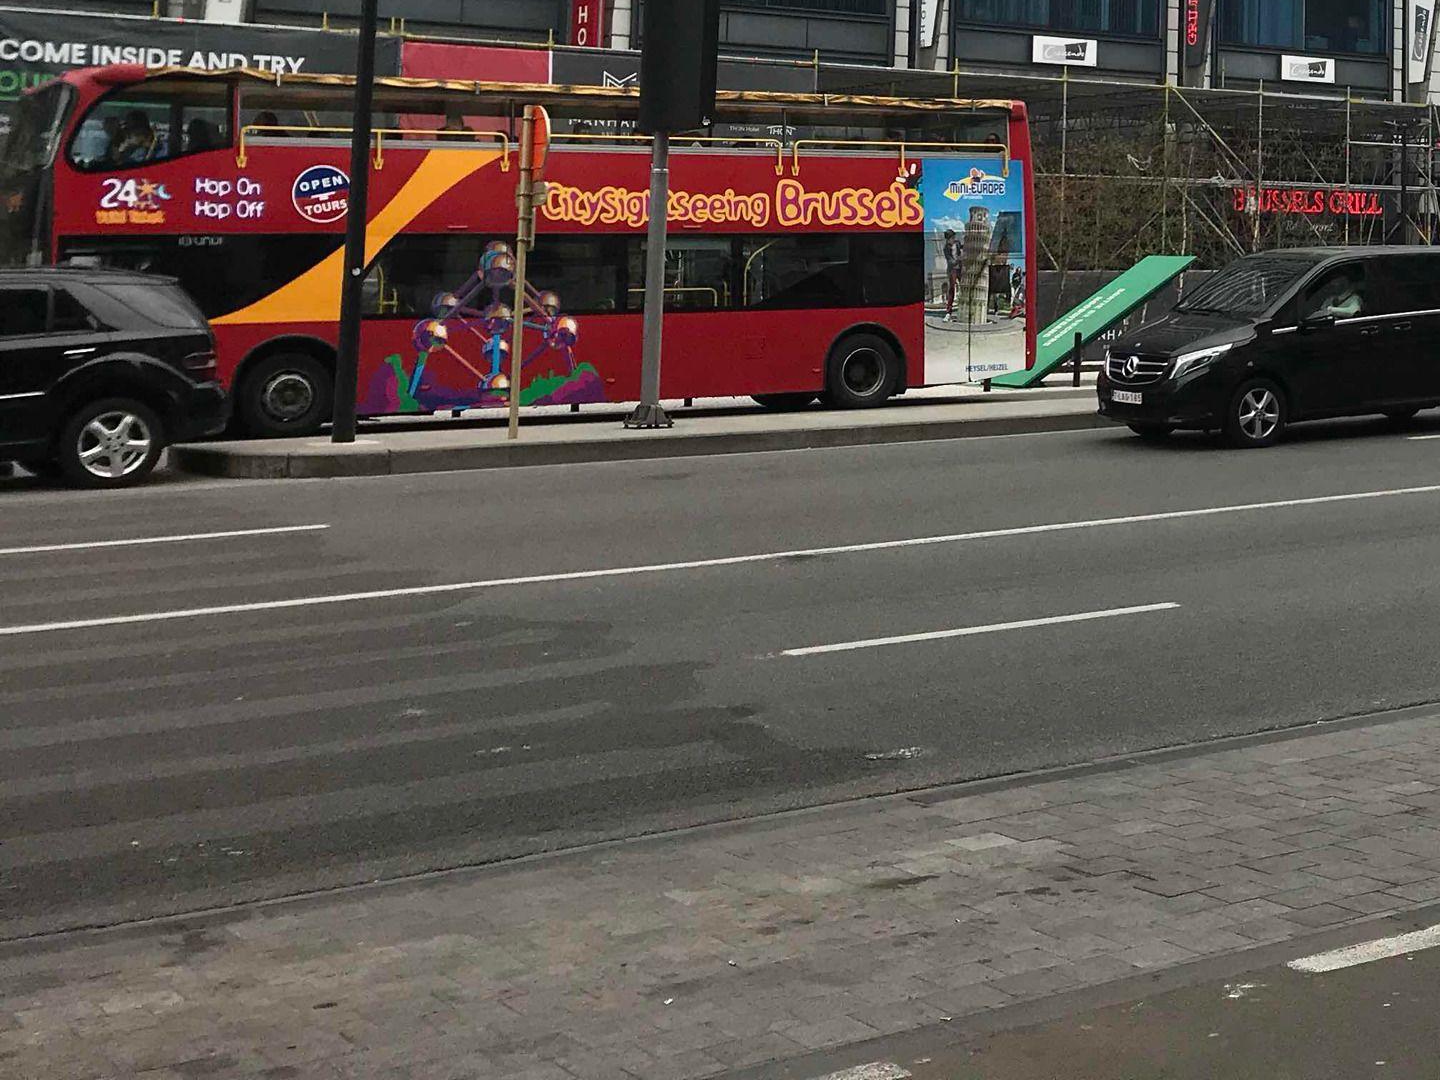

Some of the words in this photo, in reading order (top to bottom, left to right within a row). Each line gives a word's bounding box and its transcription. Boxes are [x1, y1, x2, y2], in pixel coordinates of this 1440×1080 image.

[0, 38, 86, 65] COME
[92, 45, 182, 69] INSIDE
[189, 51, 250, 70] AND
[252, 54, 306, 75] TRY
[101, 178, 138, 208] 24
[195, 177, 230, 196] Hop
[236, 177, 261, 196] On
[299, 175, 343, 193] OPEN
[195, 201, 230, 219] Hop
[236, 201, 265, 219] Off
[304, 197, 348, 216] TOURS
[541, 182, 770, 227] CitySigseeing
[776, 178, 924, 227] Brussels
[1330, 190, 1383, 214] GRILL
